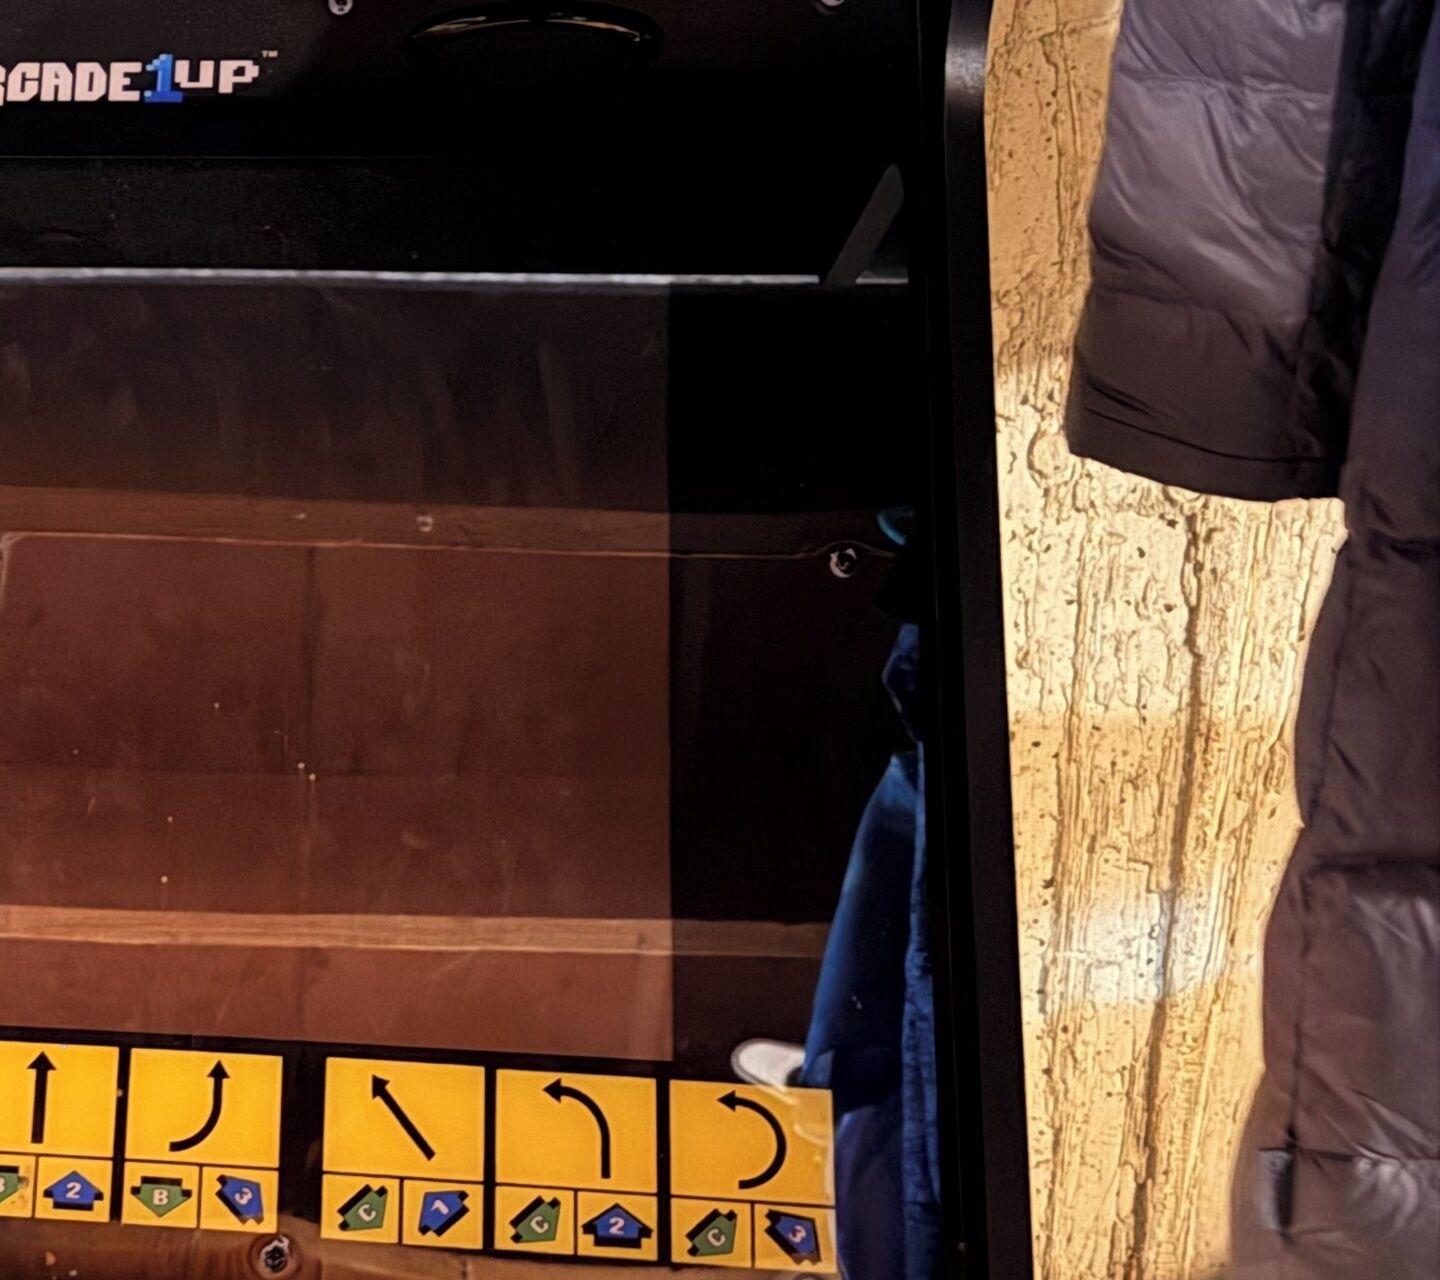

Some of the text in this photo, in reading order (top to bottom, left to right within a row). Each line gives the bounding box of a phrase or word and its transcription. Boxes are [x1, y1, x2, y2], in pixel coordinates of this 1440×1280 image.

[64, 1182, 82, 1199] 2
[152, 1188, 170, 1205] B
[234, 1187, 253, 1206] 3
[358, 1202, 377, 1222] C
[430, 1200, 449, 1216] 1
[530, 1214, 549, 1233] C
[608, 1217, 625, 1235] 2
[707, 1227, 726, 1247] C
[788, 1225, 806, 1242] 3
